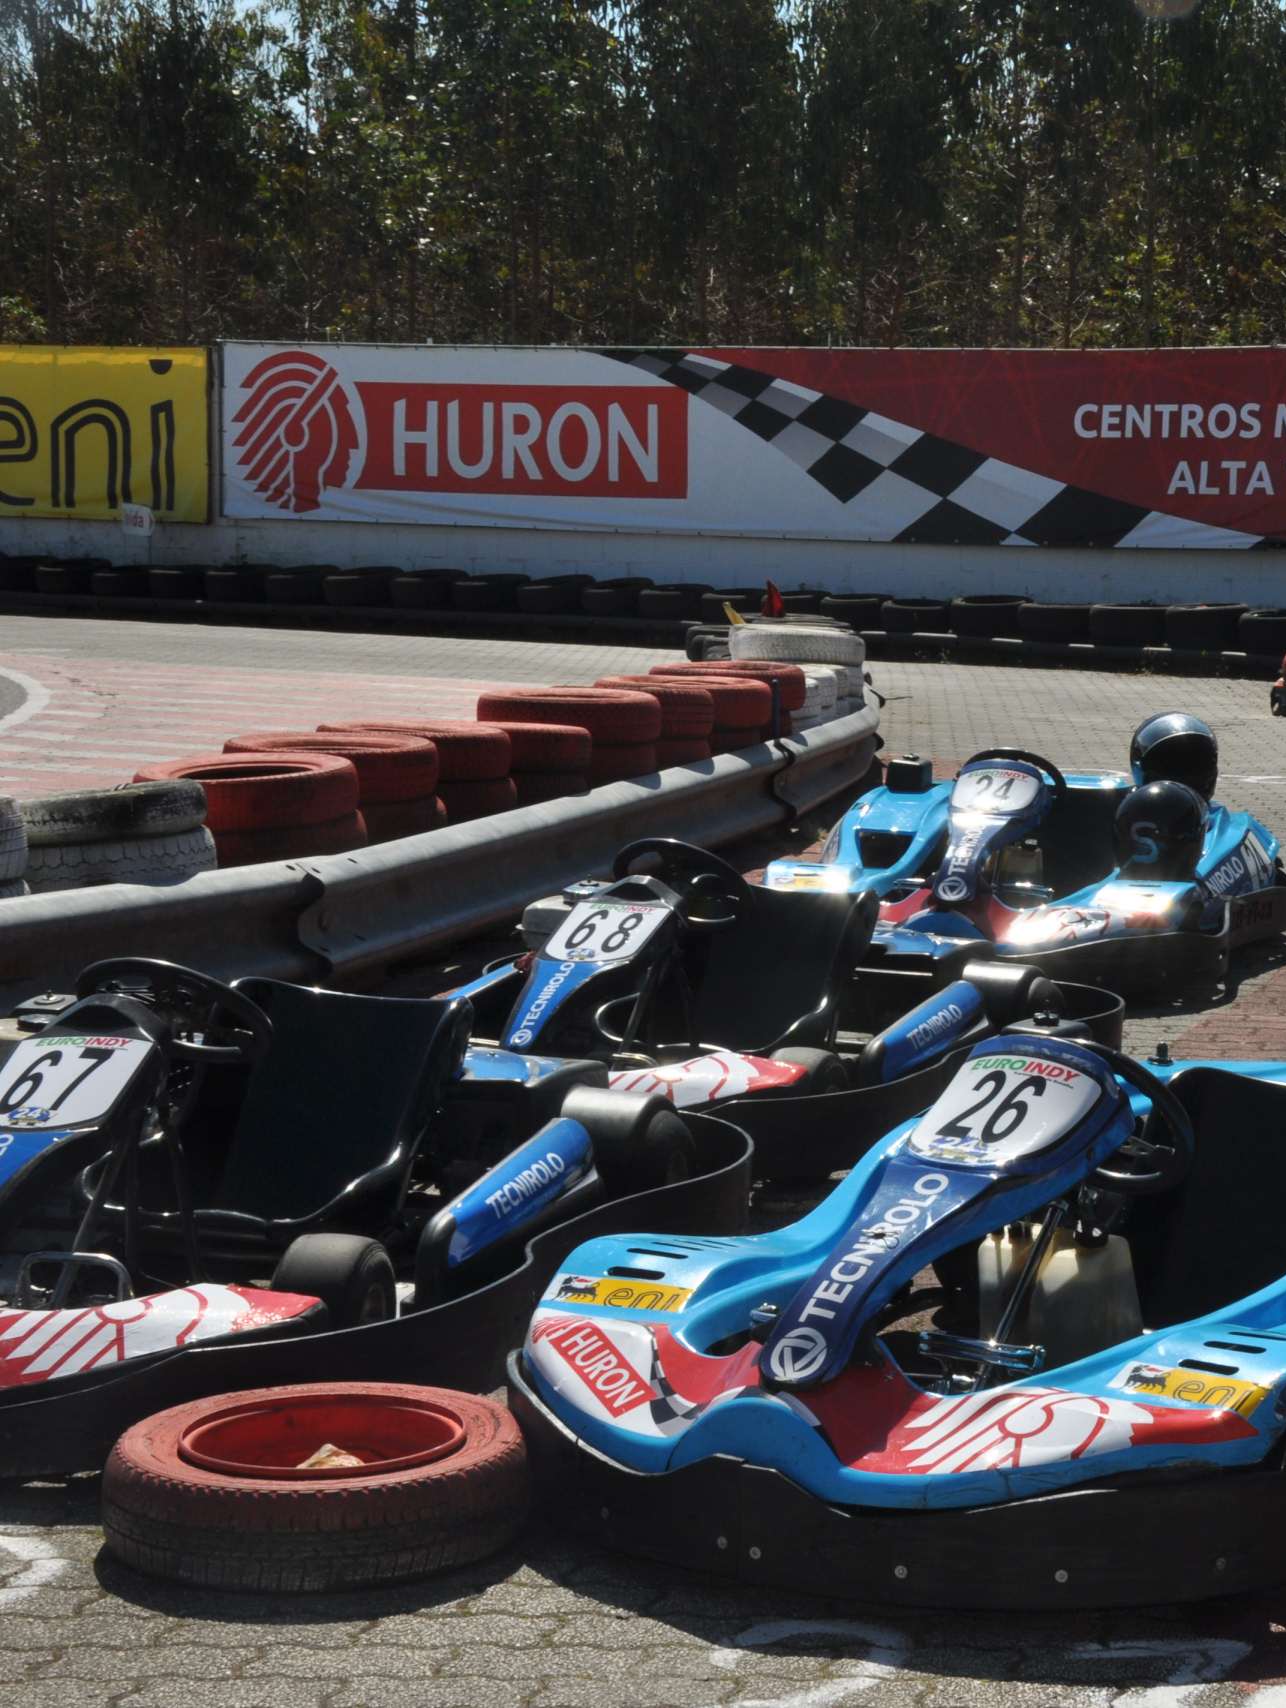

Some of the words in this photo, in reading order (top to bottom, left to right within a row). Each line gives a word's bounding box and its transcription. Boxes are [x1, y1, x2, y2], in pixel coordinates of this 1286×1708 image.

[0, 359, 175, 511] eni
[392, 399, 659, 485] HURON
[1073, 402, 1262, 439] CENTROS
[1167, 460, 1275, 496] ALTA
[975, 774, 1017, 800] 24
[1130, 821, 1160, 863] S
[564, 909, 644, 953] 68
[520, 962, 576, 1029] TECNIROLO
[36, 1036, 132, 1048] EUROINDY
[905, 1003, 962, 1050] TECNIROLO
[0, 1049, 116, 1115] 67
[971, 1057, 1082, 1082] EUROINDY
[935, 1069, 1047, 1144] 26
[484, 1152, 565, 1219] TECNIROLO
[797, 1172, 950, 1323] TECNIROLO
[561, 1327, 645, 1409] HURON
